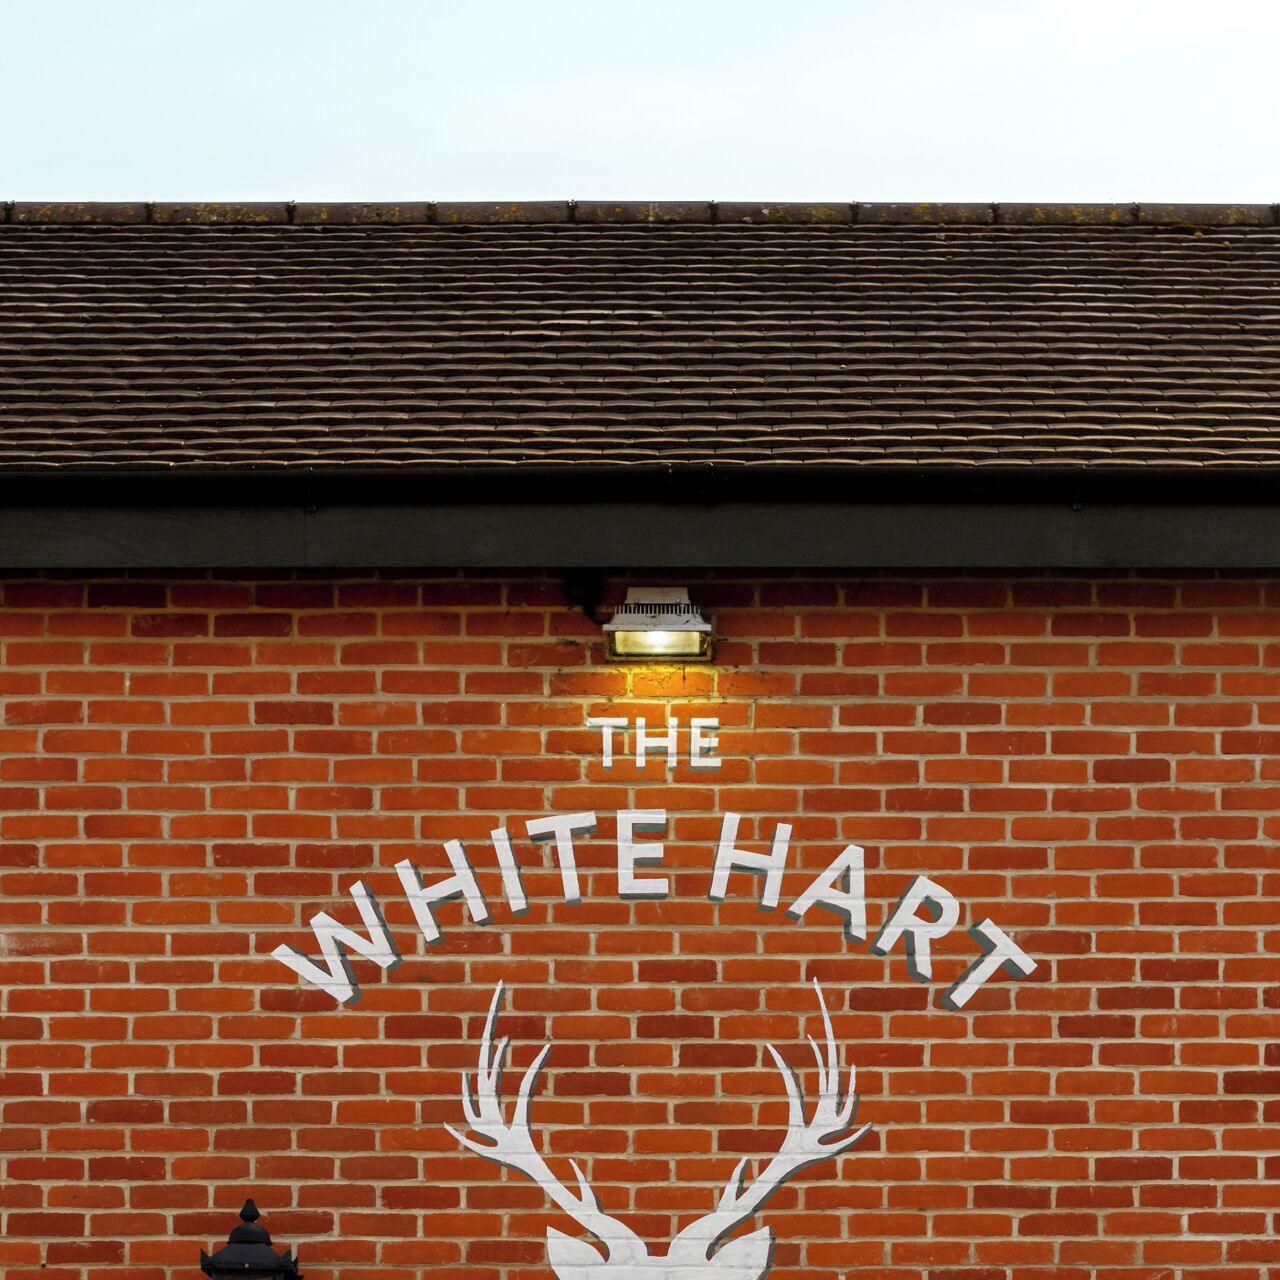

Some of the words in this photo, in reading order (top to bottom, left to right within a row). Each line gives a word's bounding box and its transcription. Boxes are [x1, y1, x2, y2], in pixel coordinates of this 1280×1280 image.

[587, 716, 722, 770] THE
[271, 808, 670, 1005] WHITE
[709, 812, 1038, 1010] HART
